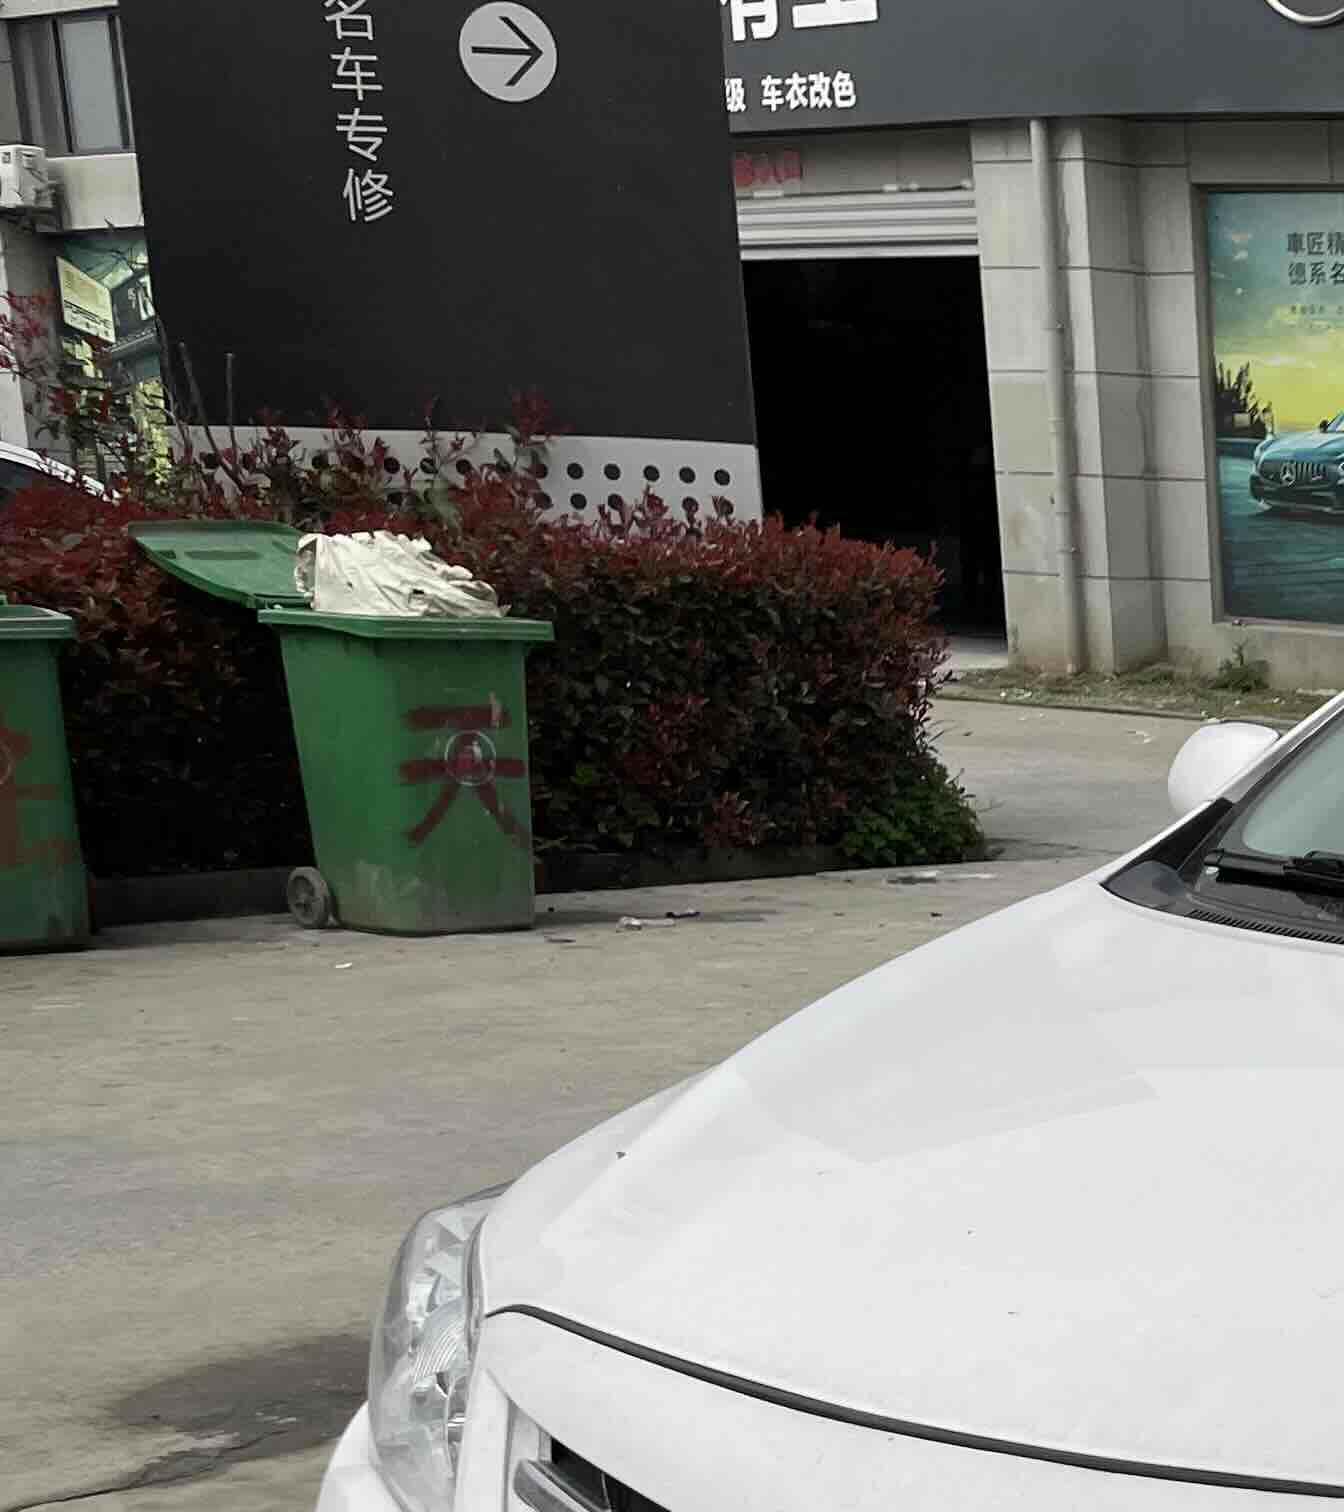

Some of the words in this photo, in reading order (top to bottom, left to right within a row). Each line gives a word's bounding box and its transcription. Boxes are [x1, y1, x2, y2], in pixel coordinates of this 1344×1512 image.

[323, 0, 394, 222] 名车专修
[761, 71, 857, 112] 车衣改色
